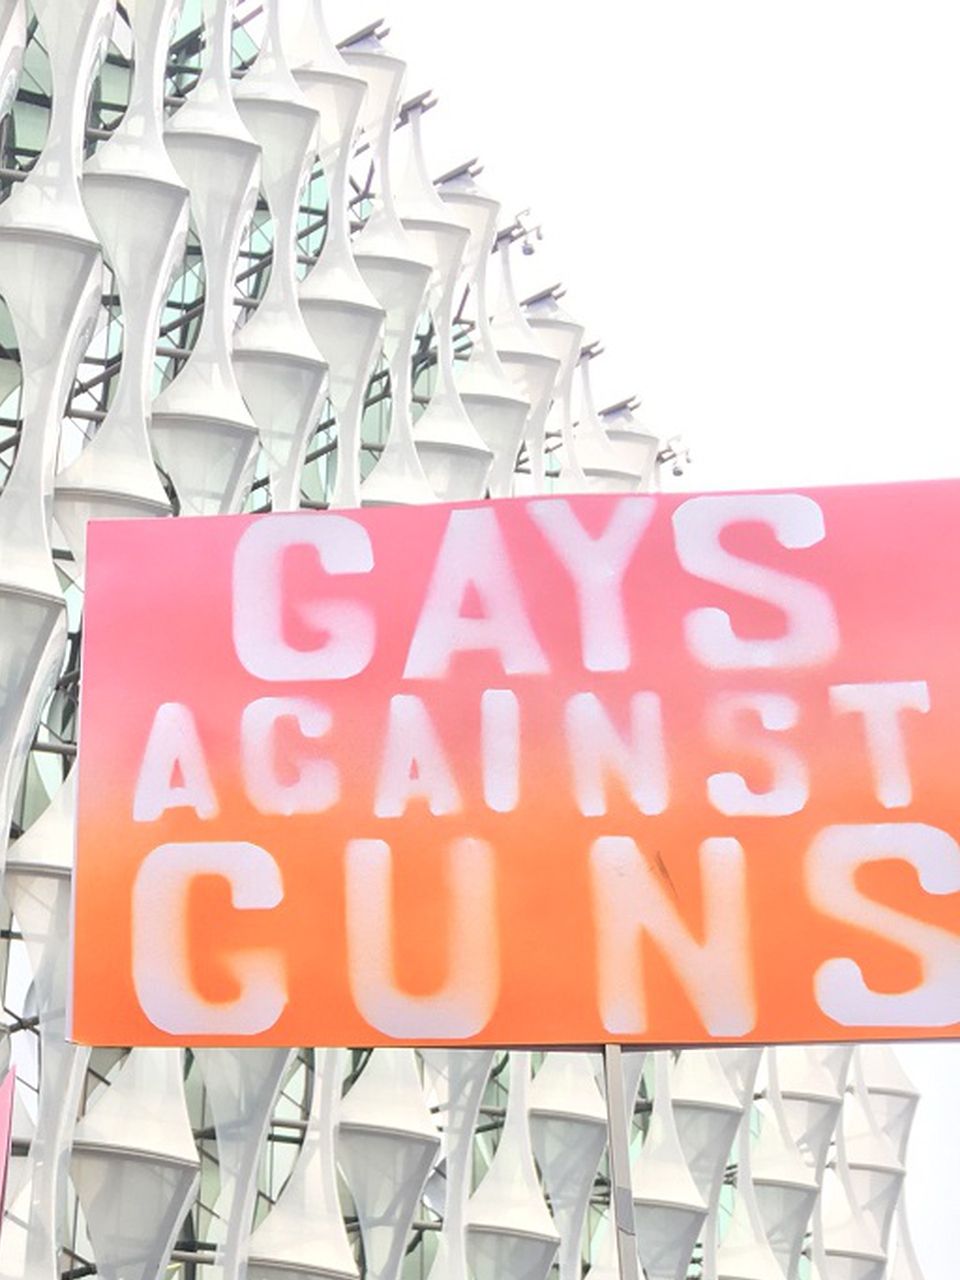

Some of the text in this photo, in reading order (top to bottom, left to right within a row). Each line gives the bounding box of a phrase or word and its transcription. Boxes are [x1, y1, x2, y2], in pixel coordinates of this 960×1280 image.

[232, 494, 840, 682] GAYS
[132, 680, 931, 823] AGAINST
[131, 822, 960, 1040] GUNS
